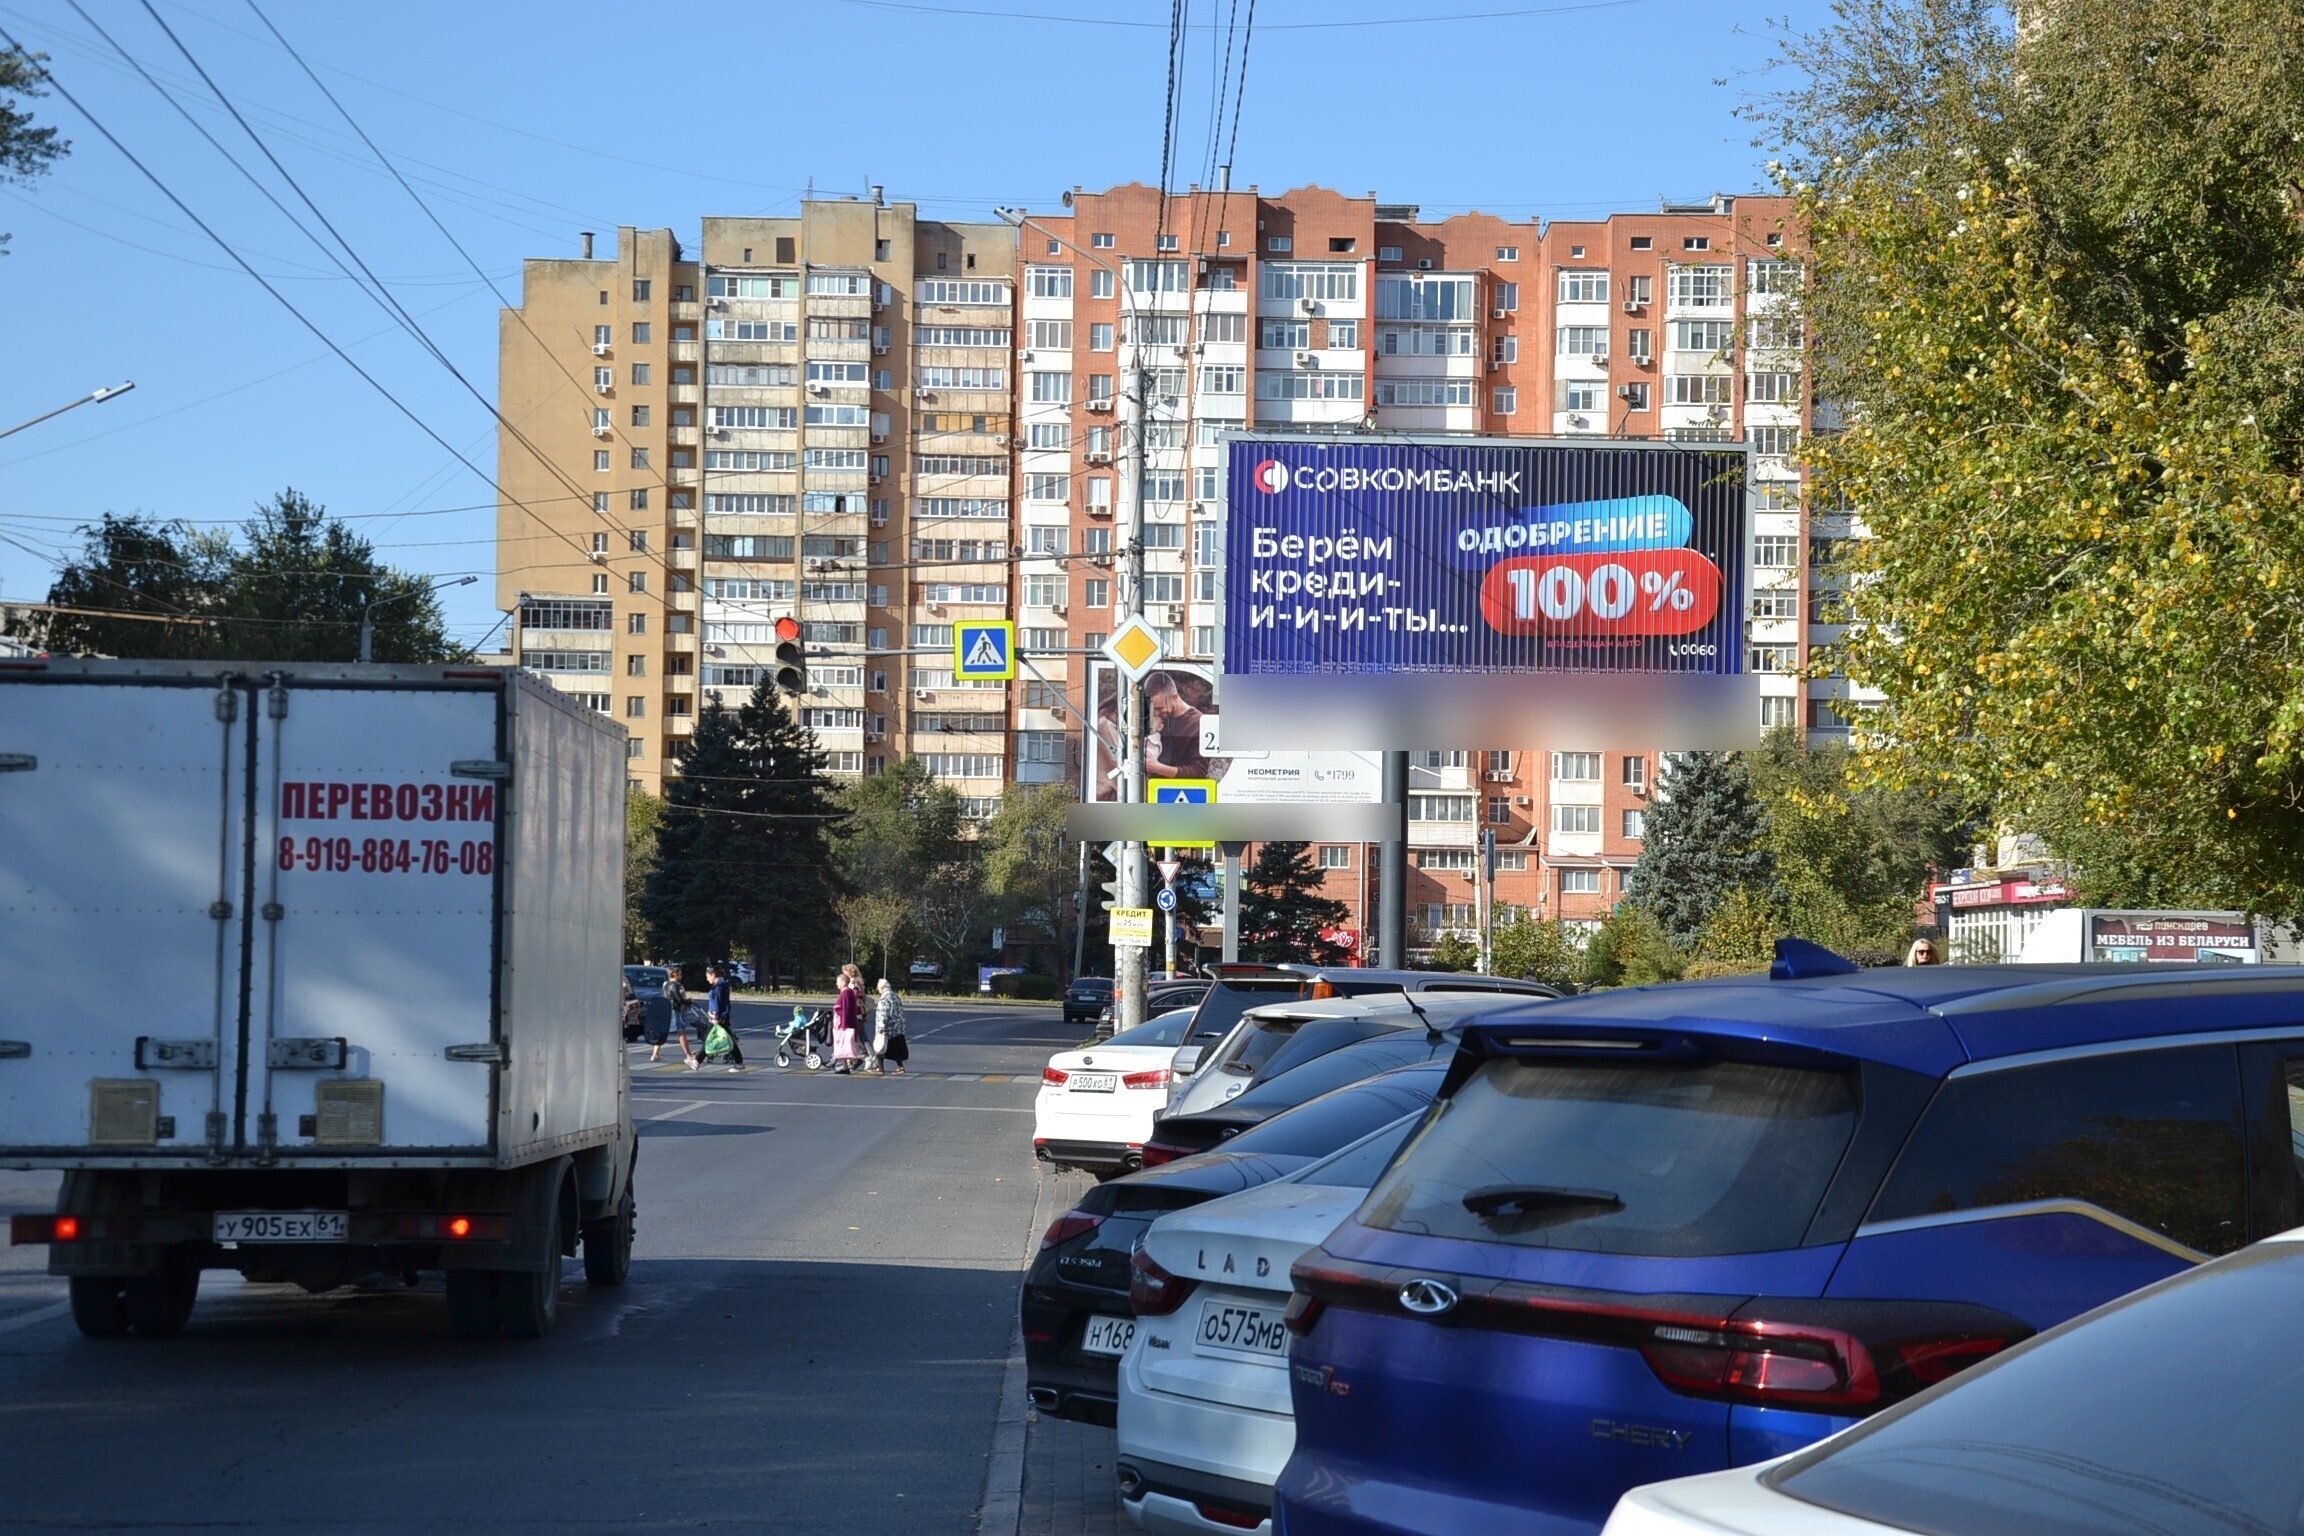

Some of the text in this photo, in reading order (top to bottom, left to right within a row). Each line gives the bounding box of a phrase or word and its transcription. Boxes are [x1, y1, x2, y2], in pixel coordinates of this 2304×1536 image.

[1293, 465, 1521, 494] СОВКОМБАНК
[1252, 526, 1393, 567] Берём
[1457, 512, 1669, 555] ОДОБРЕНИЕ
[1251, 568, 1402, 601] креди-
[1506, 562, 1696, 621] 100%
[1680, 643, 1718, 656] 0060
[1247, 768, 1300, 776] НЕОМЕТРИЯ
[281, 782, 494, 822] ПЕРЕВОЗКИ
[278, 836, 494, 875] 8-919-884-76-08
[1116, 910, 1147, 918] КРЕДИТ
[2096, 934, 2250, 947] МЕБЕЛЬ ИЗ БЕЛАРУСИ
[317, 1215, 340, 1231] 61
[1590, 1418, 1694, 1450] CHERY
